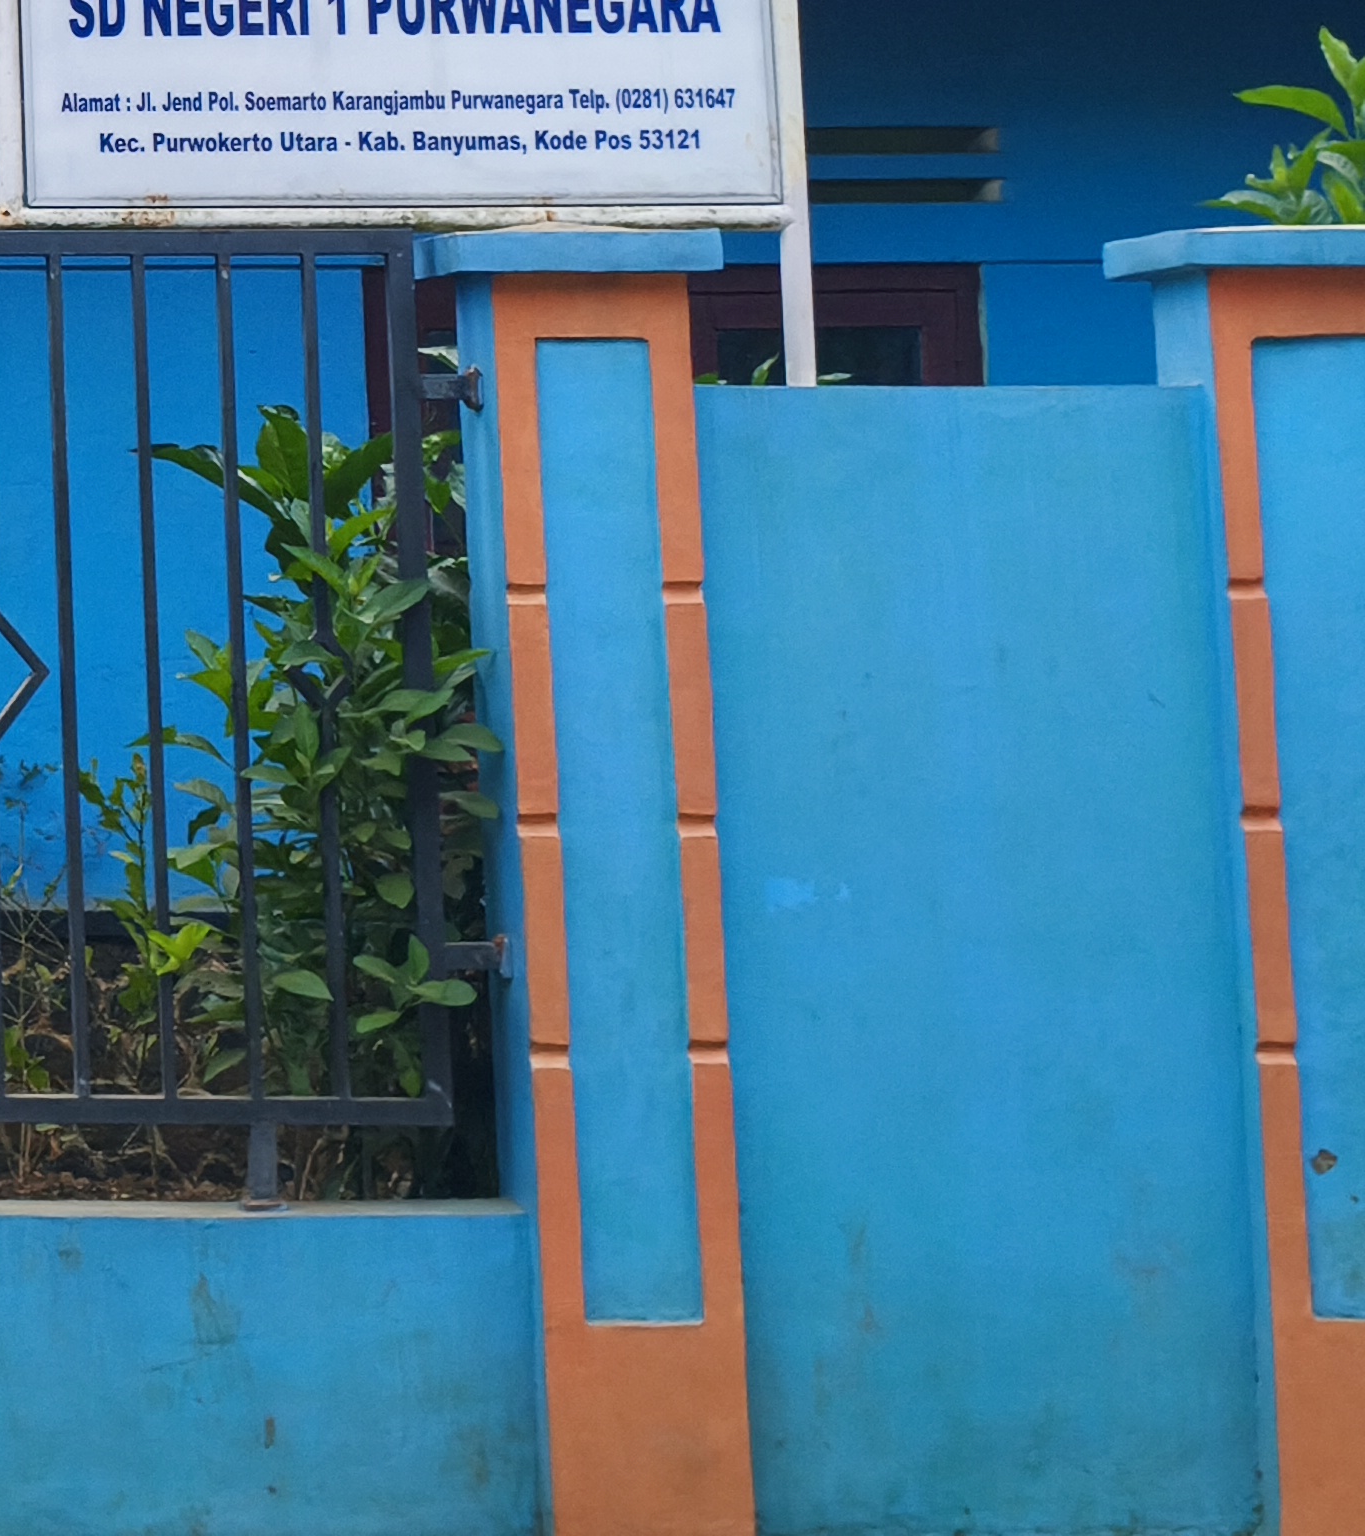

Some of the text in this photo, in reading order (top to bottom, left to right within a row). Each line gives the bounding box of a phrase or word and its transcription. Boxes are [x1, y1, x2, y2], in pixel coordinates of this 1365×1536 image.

[62, 93, 120, 112] Alamat
[137, 92, 156, 111] Jl.
[162, 92, 202, 111] Jend
[209, 92, 238, 111] Pol.
[245, 92, 326, 111] Soemarto
[333, 90, 445, 115] Karangjambu
[451, 90, 563, 114] Purwanegara
[569, 89, 609, 113] Telp.
[616, 89, 668, 114] (0281)
[675, 88, 735, 108] 631647
[100, 133, 144, 152] Kec.
[153, 132, 272, 152] Purwokerto
[281, 132, 337, 151] Utara
[359, 131, 405, 151] Kab.
[413, 131, 526, 156] Banyumas,
[535, 130, 587, 150] Kode
[595, 130, 631, 149] Pos
[640, 129, 699, 149] 53121
